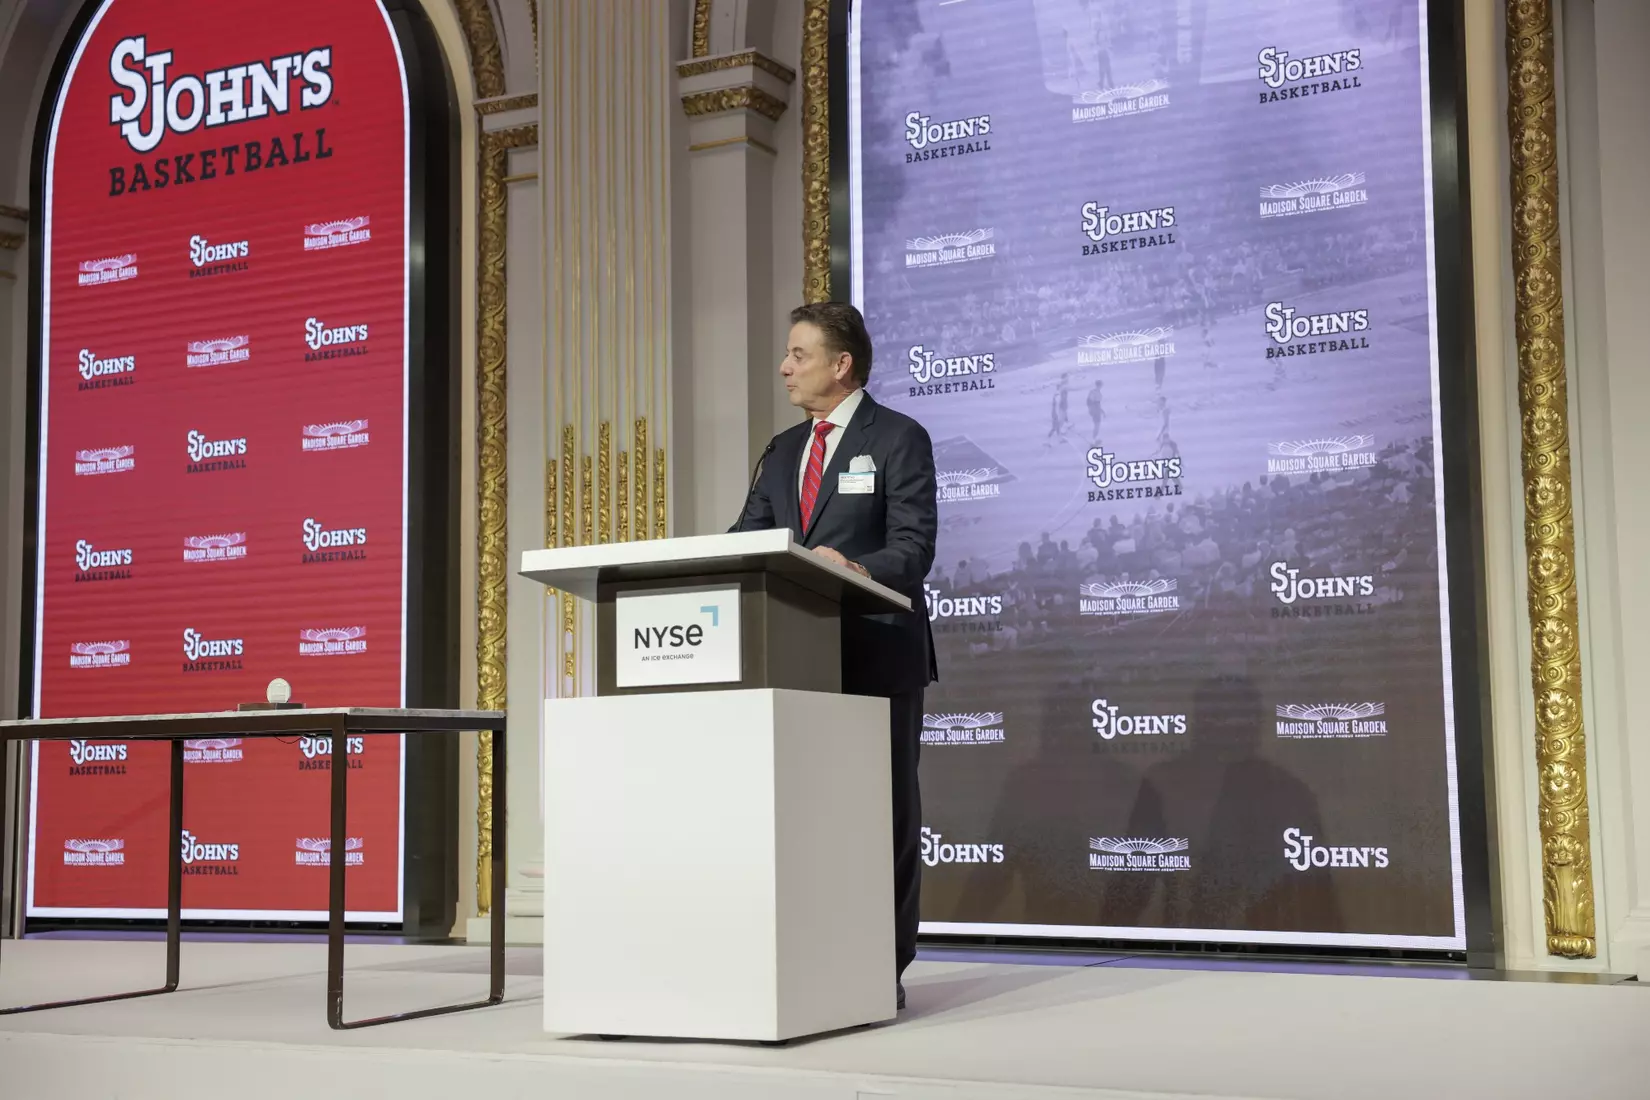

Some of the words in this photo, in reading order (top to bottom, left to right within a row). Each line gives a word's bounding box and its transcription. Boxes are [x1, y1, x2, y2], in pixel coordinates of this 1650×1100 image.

[1260, 77, 1362, 103] BASKETBALL
[1072, 104, 1106, 120] MADISON
[1108, 98, 1138, 114] SQUARE
[906, 141, 990, 163] BASKETBALL
[109, 128, 333, 196] BASKETBALL
[1260, 200, 1297, 216] MADISON
[1299, 195, 1331, 211] SQUARE
[1082, 233, 1175, 256] BASKETBALL
[905, 252, 937, 266] MADISON
[938, 248, 965, 262] SQUARE
[190, 262, 249, 278] BASKETBALL
[305, 346, 369, 362] BASKETBALL
[1266, 337, 1369, 359] BASKETBALL
[1078, 350, 1111, 365] MADISON
[1113, 347, 1143, 361] SQUARE
[79, 376, 135, 390] BASKETBALL
[909, 379, 995, 397] BASKETBALL
[187, 459, 247, 473] BASKETBALL
[1268, 458, 1305, 473] MADISON
[1307, 455, 1340, 470] SQUARE
[942, 487, 970, 499] SQUARE
[1087, 485, 1182, 502] BASKETBALL
[302, 549, 367, 563] BASKETBALL
[75, 569, 132, 582] BASKETBALL
[1080, 599, 1114, 612] MADISON
[1116, 597, 1146, 611] SQUARE
[1271, 604, 1376, 619] BASKETBALL
[183, 660, 243, 672] BASKETBALL
[919, 731, 945, 741] ADISON
[946, 729, 975, 741] SQUARE
[1277, 722, 1314, 735] MADISON
[1317, 721, 1350, 734] SQUARE
[69, 765, 127, 776] BASKETBALL
[299, 759, 364, 771] BASKEALL
[1089, 853, 1124, 867] MADISON
[1126, 853, 1157, 867] SQUARE
[181, 865, 239, 876] ASKETBALL
